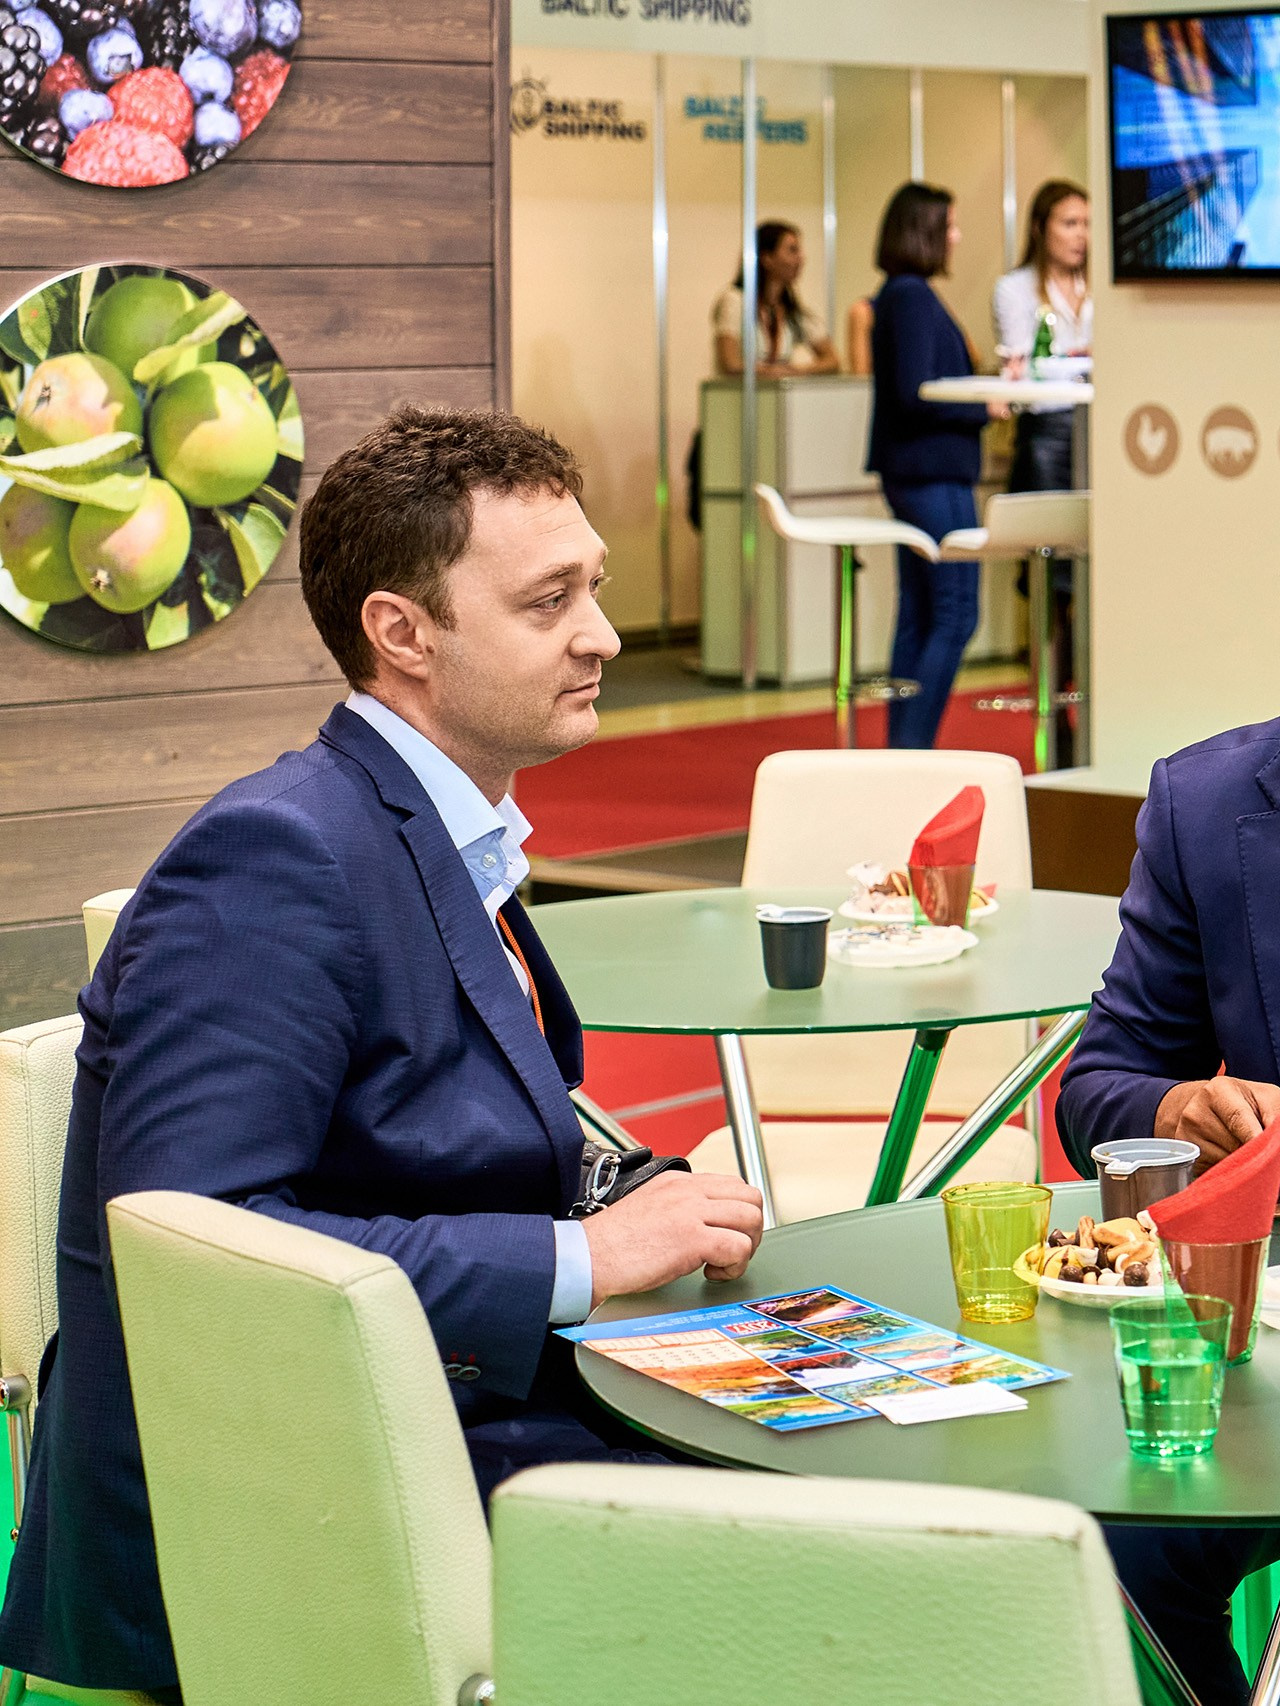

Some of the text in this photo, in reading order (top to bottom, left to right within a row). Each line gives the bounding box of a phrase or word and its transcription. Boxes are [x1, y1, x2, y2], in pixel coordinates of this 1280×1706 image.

[639, 0, 751, 27] SHIPPING
[544, 99, 621, 119] BALTIC
[545, 121, 647, 141] SHIPPING
